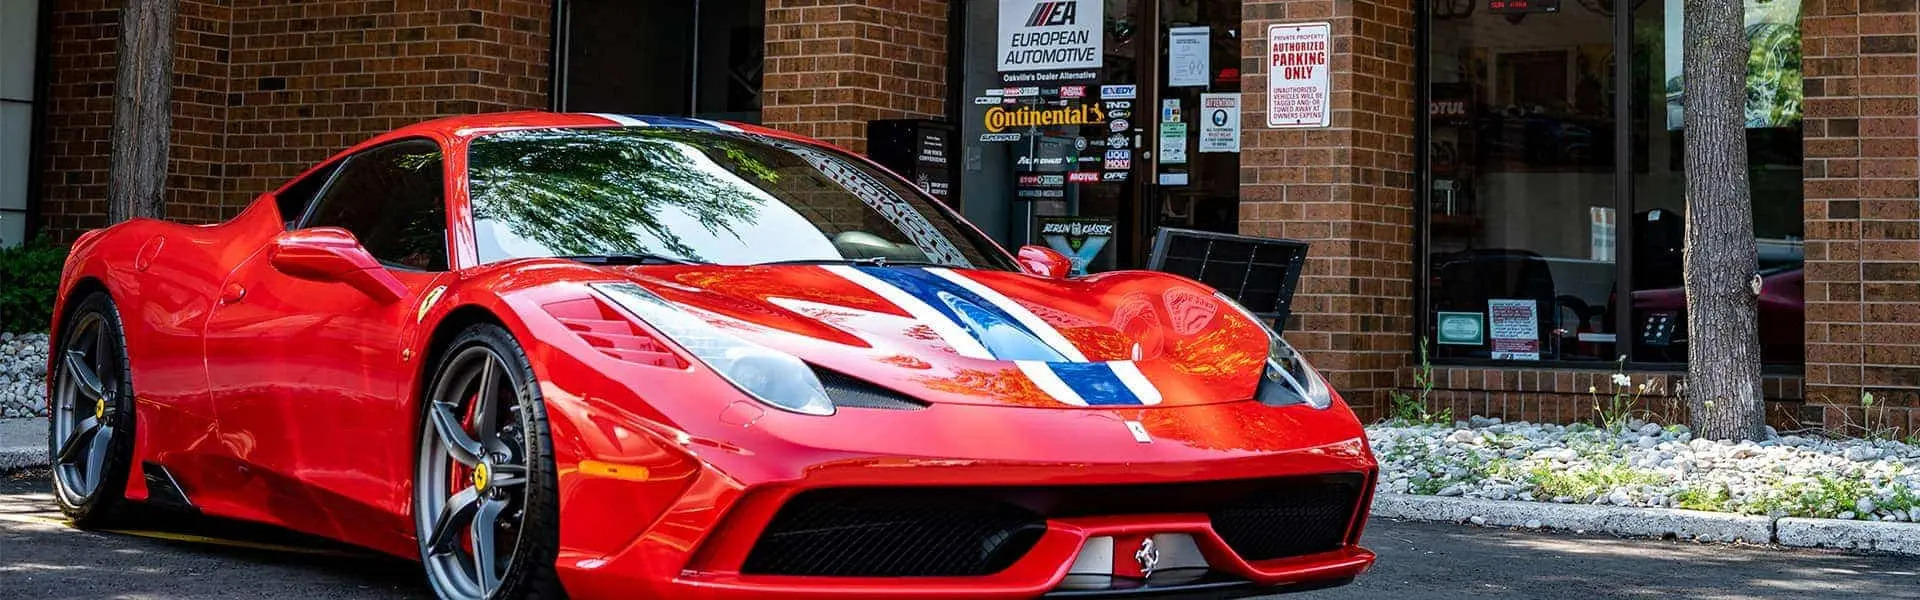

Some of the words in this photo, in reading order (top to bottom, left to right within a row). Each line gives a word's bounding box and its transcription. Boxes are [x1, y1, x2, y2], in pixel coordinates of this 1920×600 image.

[1011, 30, 1090, 47] EUROPEAN
[1272, 41, 1325, 53] AUTHORIZED
[1005, 48, 1096, 64] AUTOMOTIVE
[1272, 52, 1325, 67] PARKING
[1003, 73, 1036, 82] Oakville's
[1036, 72, 1059, 81] Dealer
[1060, 71, 1097, 80] Alternative
[1284, 66, 1313, 80] ONLY
[1102, 87, 1134, 95] EXEDY
[1431, 101, 1464, 114] OTUL
[984, 103, 1088, 133] Continental
[1106, 151, 1129, 160] LIQUI
[1106, 160, 1129, 168] MOLY
[1070, 173, 1099, 182] MOTUL
[1042, 223, 1071, 233] BERLIN
